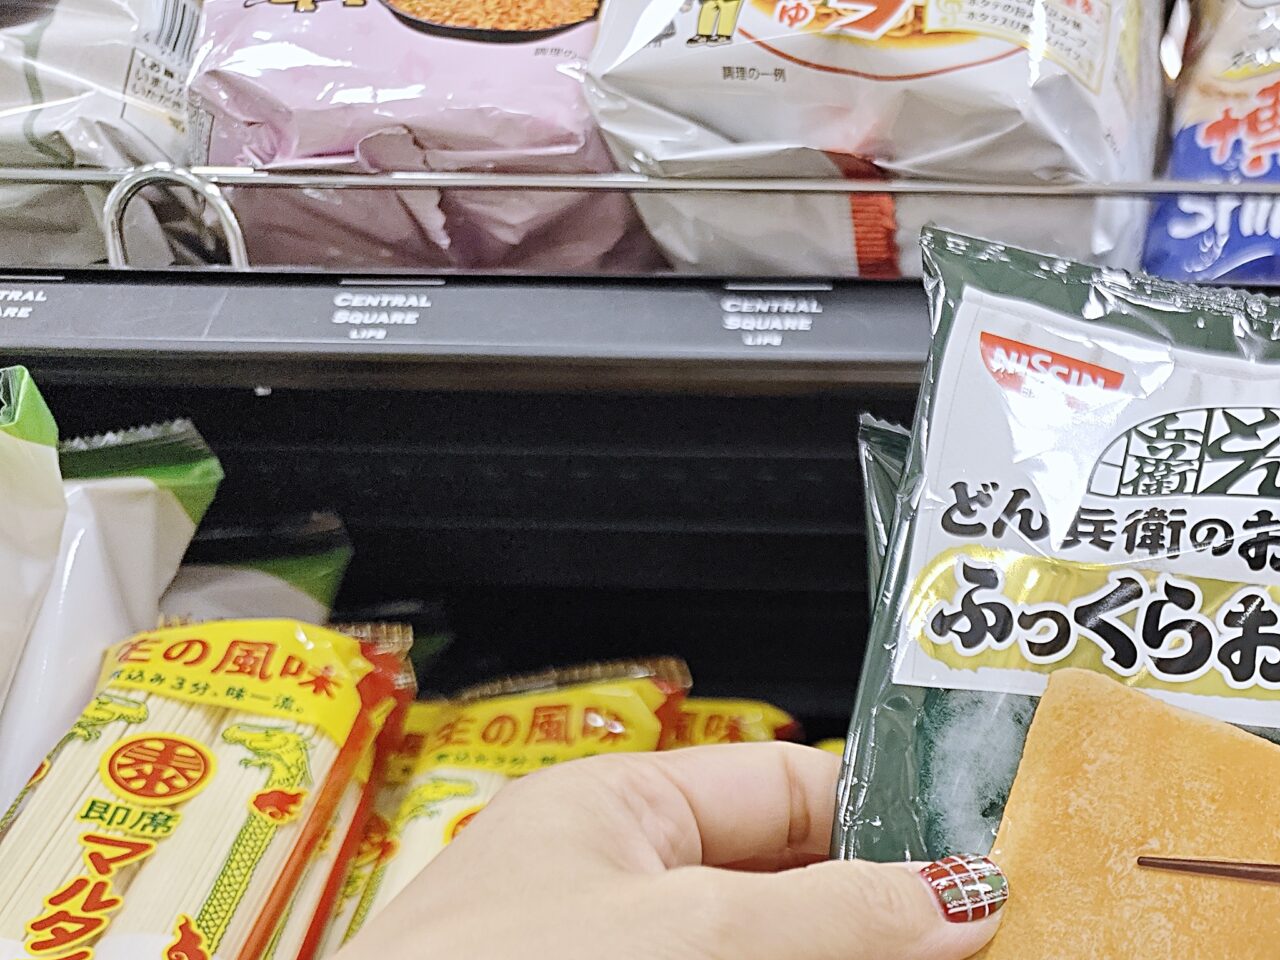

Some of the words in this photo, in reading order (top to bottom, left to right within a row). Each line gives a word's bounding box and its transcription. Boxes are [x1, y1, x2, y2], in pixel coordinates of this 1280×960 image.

[721, 65, 787, 82] 調理の一例
[333, 292, 432, 308] CENTRAL
[720, 297, 823, 313] CENTRAL
[332, 309, 420, 325] SQUARE
[722, 313, 813, 331] SQUARE
[989, 347, 1106, 390] NISSIN
[81, 799, 179, 835] 即席
